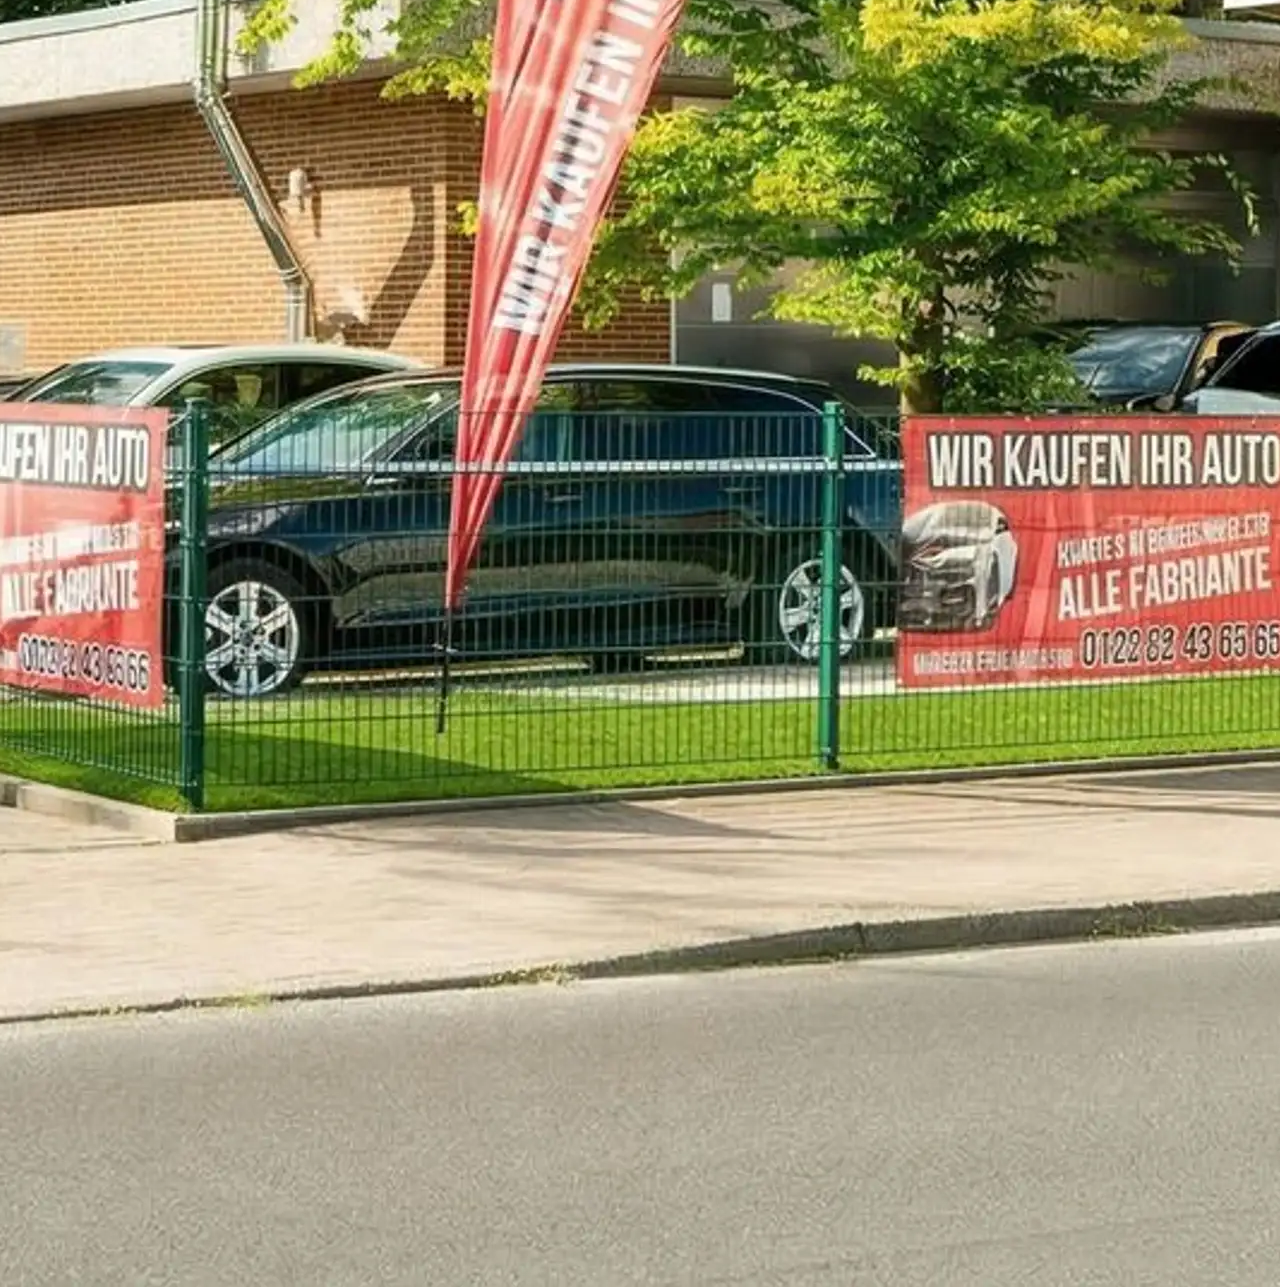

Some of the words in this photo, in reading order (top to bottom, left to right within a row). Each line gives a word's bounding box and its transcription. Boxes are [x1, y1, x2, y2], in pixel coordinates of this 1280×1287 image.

[492, 234, 568, 336] WIR
[532, 31, 646, 231] KAUFEN
[54, 424, 89, 484] IHR
[92, 428, 150, 489] AUTO
[928, 433, 994, 488] WIR
[1003, 433, 1131, 487] KAUFEN
[1140, 434, 1194, 486] IHR
[1057, 569, 1122, 621] ALLE
[1129, 546, 1272, 610] FABRIANTE
[1182, 622, 1214, 662] 43
